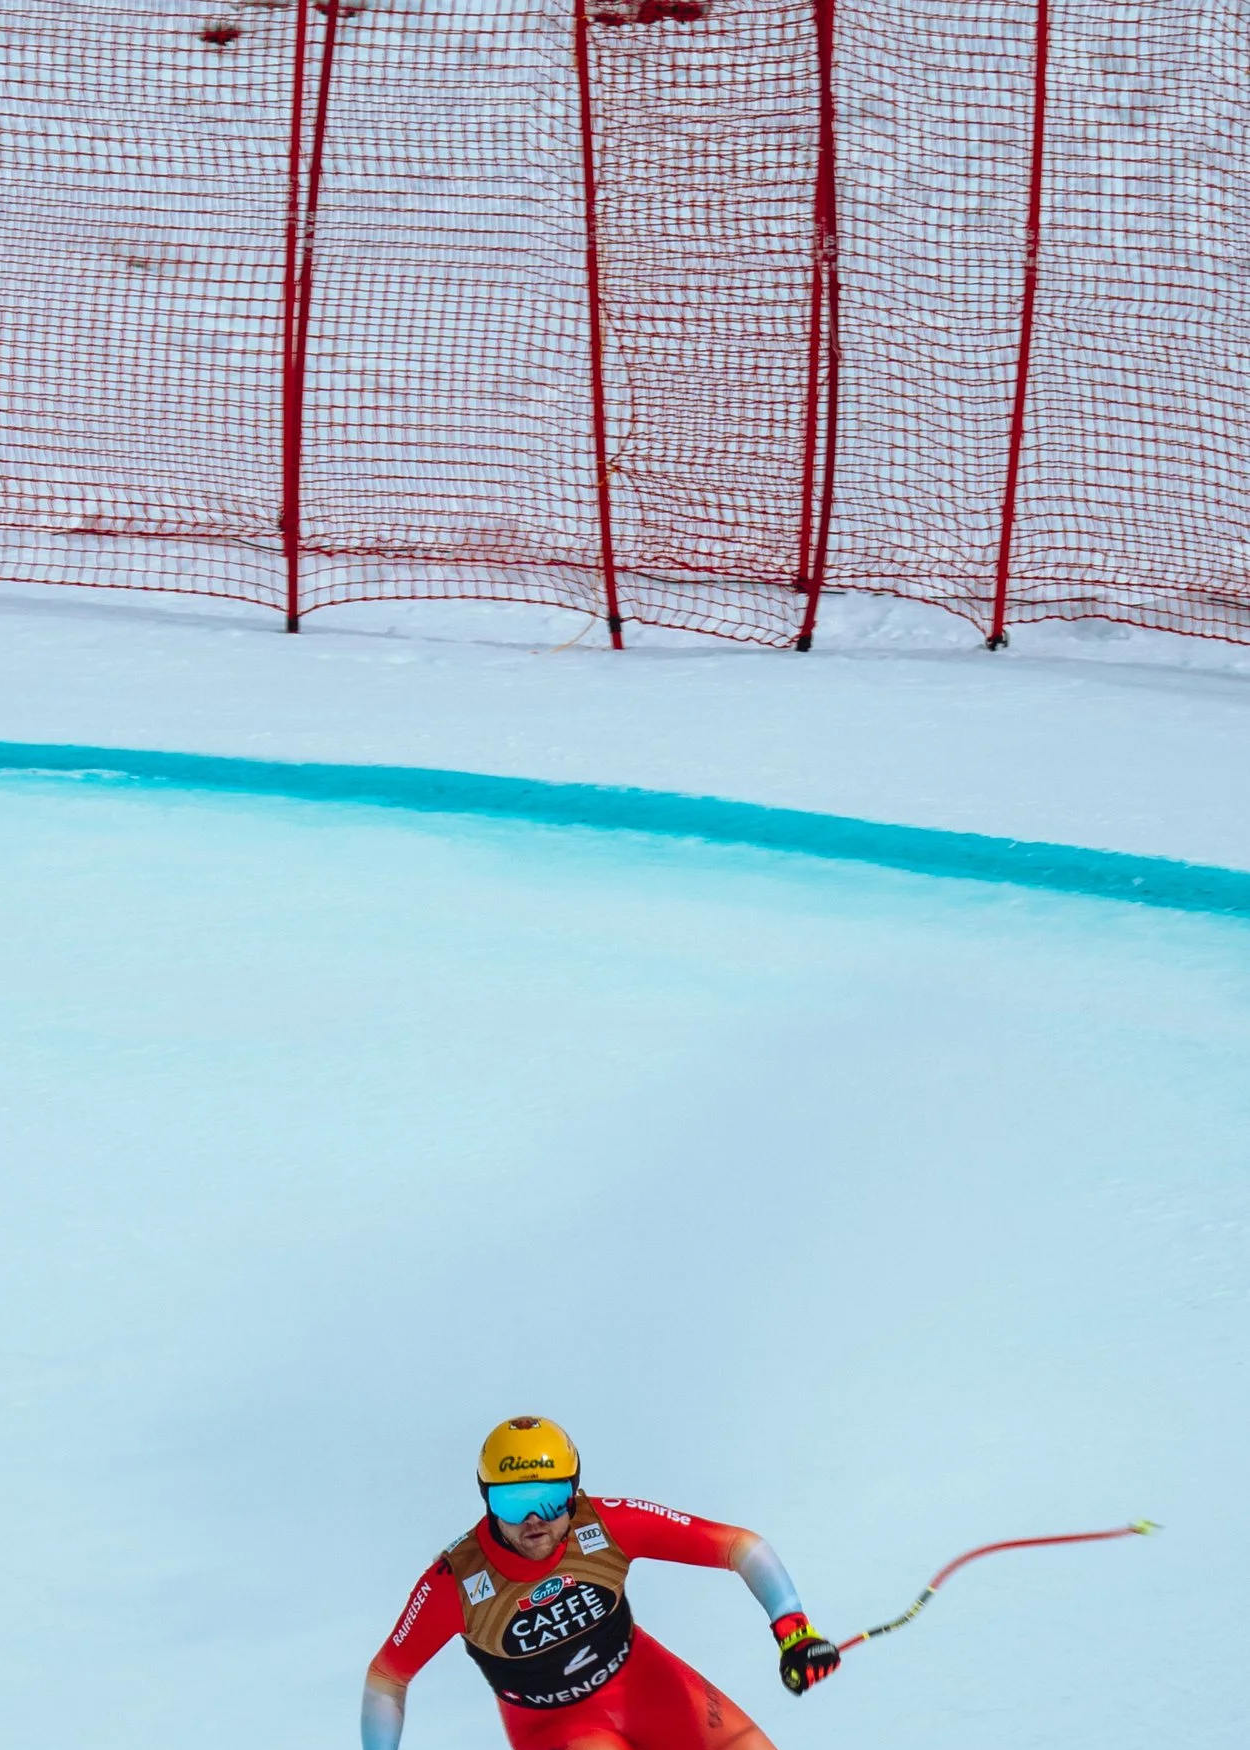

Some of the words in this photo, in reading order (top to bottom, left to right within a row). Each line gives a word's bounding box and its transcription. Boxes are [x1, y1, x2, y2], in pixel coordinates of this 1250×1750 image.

[498, 1455, 555, 1472] Ricola
[625, 1499, 692, 1526] Sunrise
[392, 1581, 432, 1647] RAIFFEISEN
[512, 1585, 601, 1636] CAFFÈ
[532, 1581, 560, 1600] Emmi
[519, 1603, 607, 1652] LATTE
[525, 1641, 630, 1704] WENGEN
